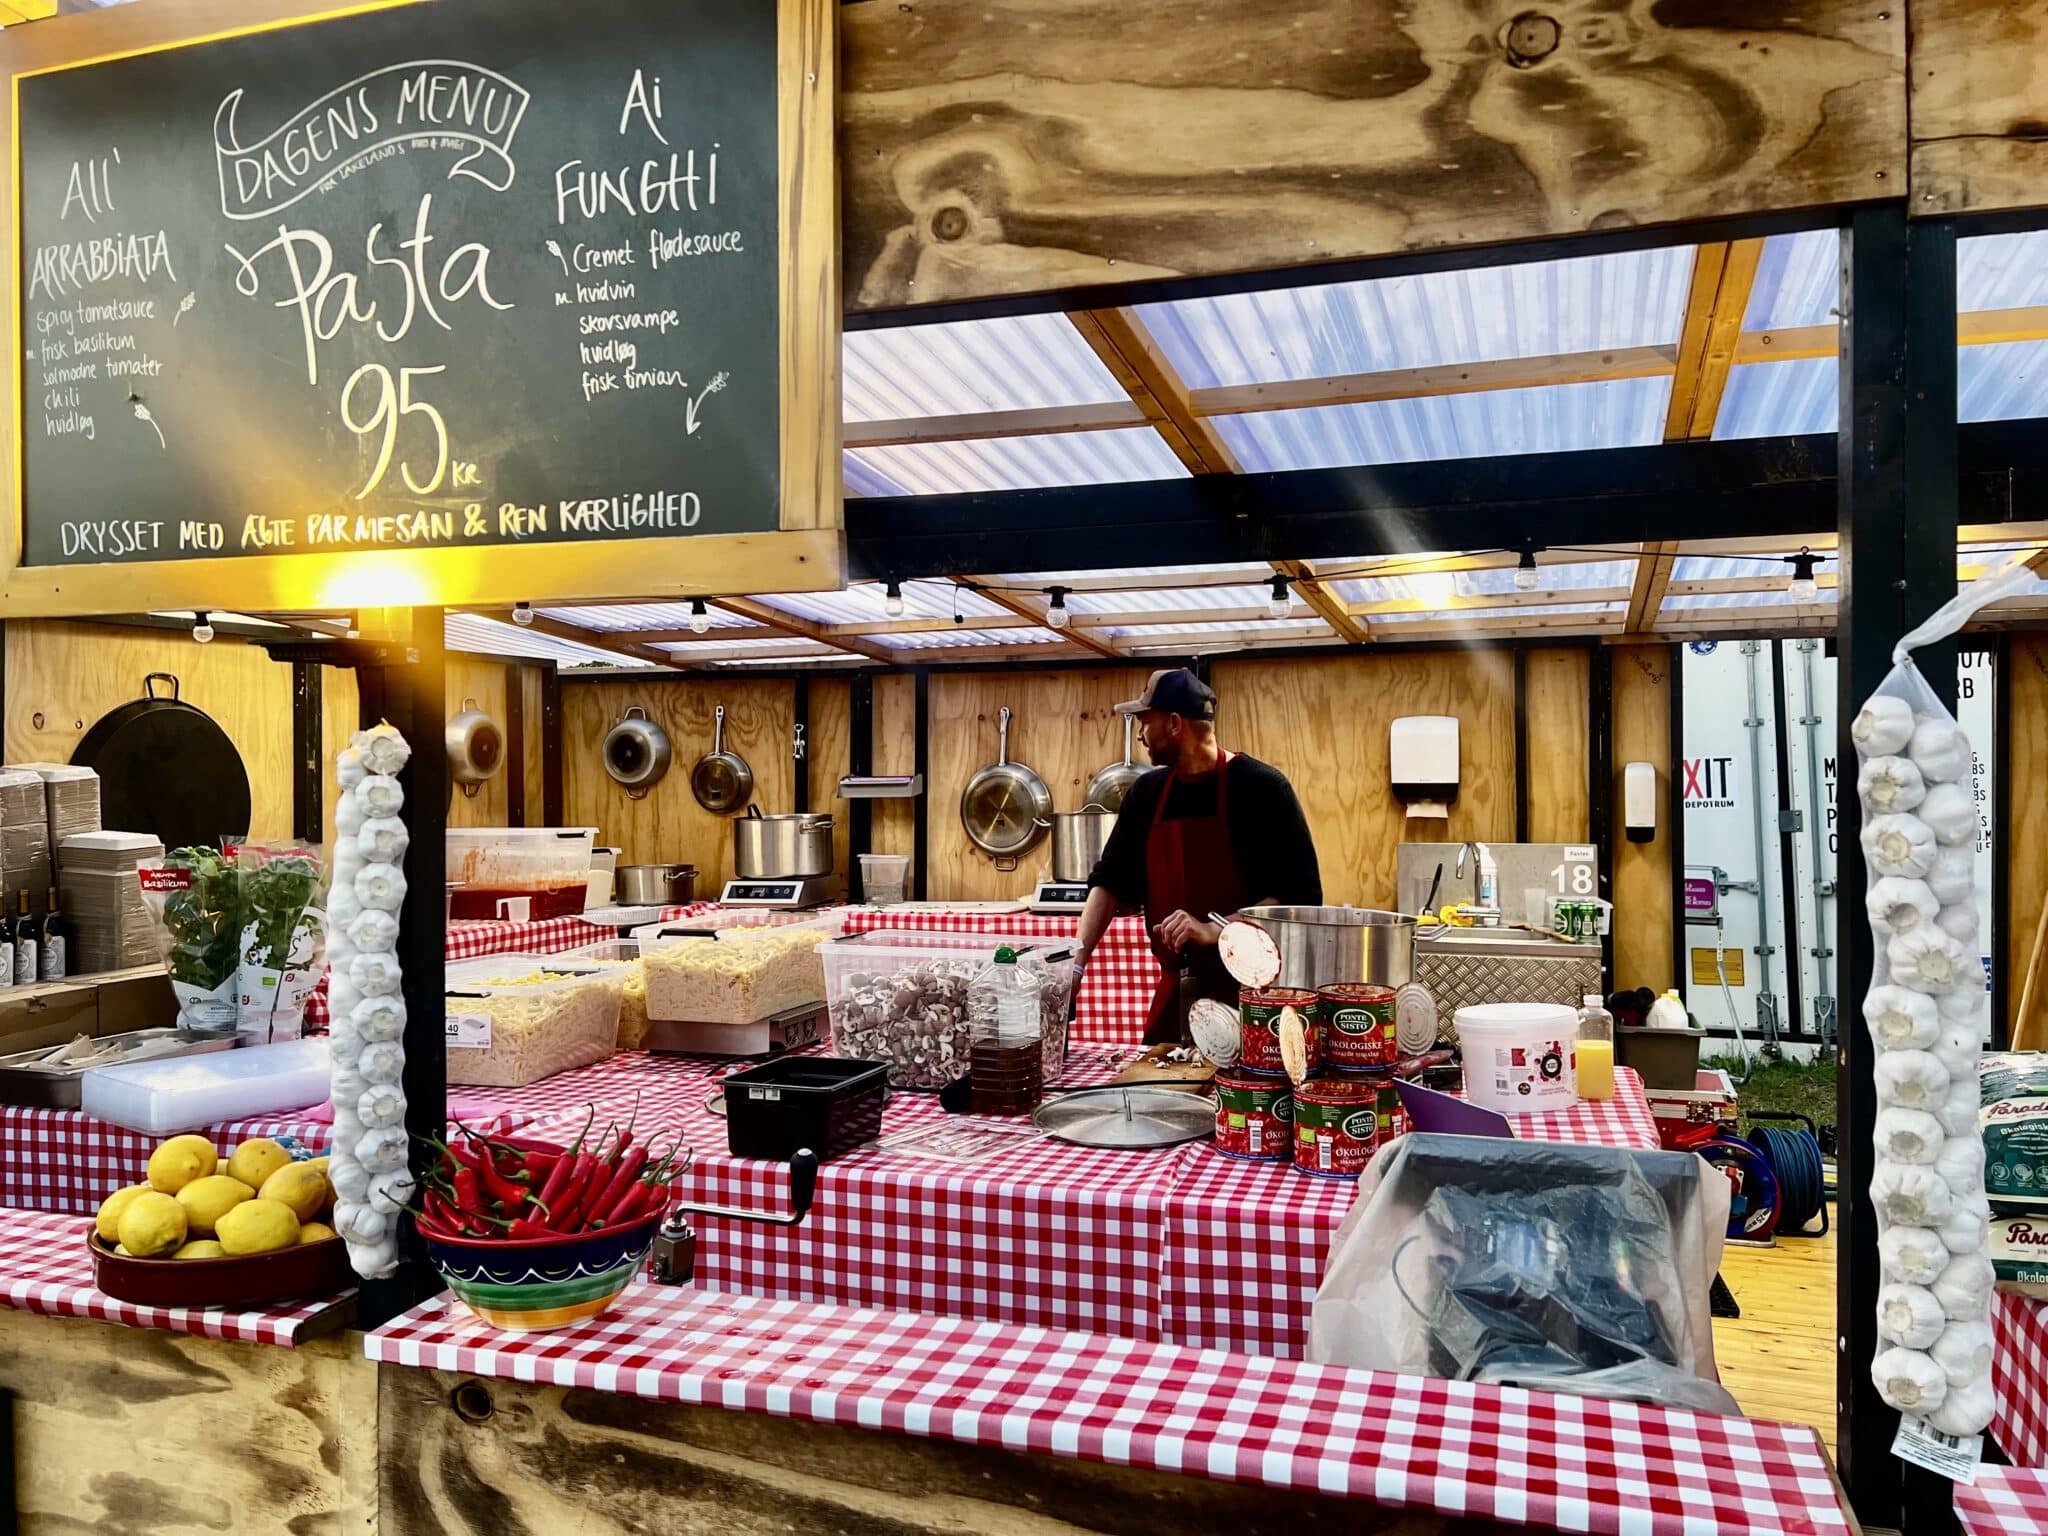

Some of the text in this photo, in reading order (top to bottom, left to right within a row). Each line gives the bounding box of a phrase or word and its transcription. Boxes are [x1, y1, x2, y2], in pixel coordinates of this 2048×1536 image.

[235, 71, 513, 204] DAGENS MENU
[572, 229, 745, 273] Cremet flødesauce
[223, 193, 516, 386] Pasta
[576, 281, 636, 305] hvidvin
[76, 299, 155, 324] tomatsauce
[579, 308, 679, 335] skovsvampe
[73, 331, 137, 355] basilikum
[580, 341, 637, 370] hvidløg
[43, 355, 164, 387] solmodne tomater
[581, 368, 688, 401] frisk timian
[44, 386, 80, 410] chili
[45, 410, 95, 440] hvidløg
[340, 363, 448, 500] 95
[60, 521, 164, 557] DRYSSET
[179, 521, 224, 551] MED
[463, 502, 488, 538] &
[498, 501, 547, 540] REN
[1685, 800, 1735, 809] DEPOTRUM
[143, 879, 189, 889] Basilikum
[1550, 864, 1594, 894] 18
[1340, 1022, 1369, 1030] SISTO
